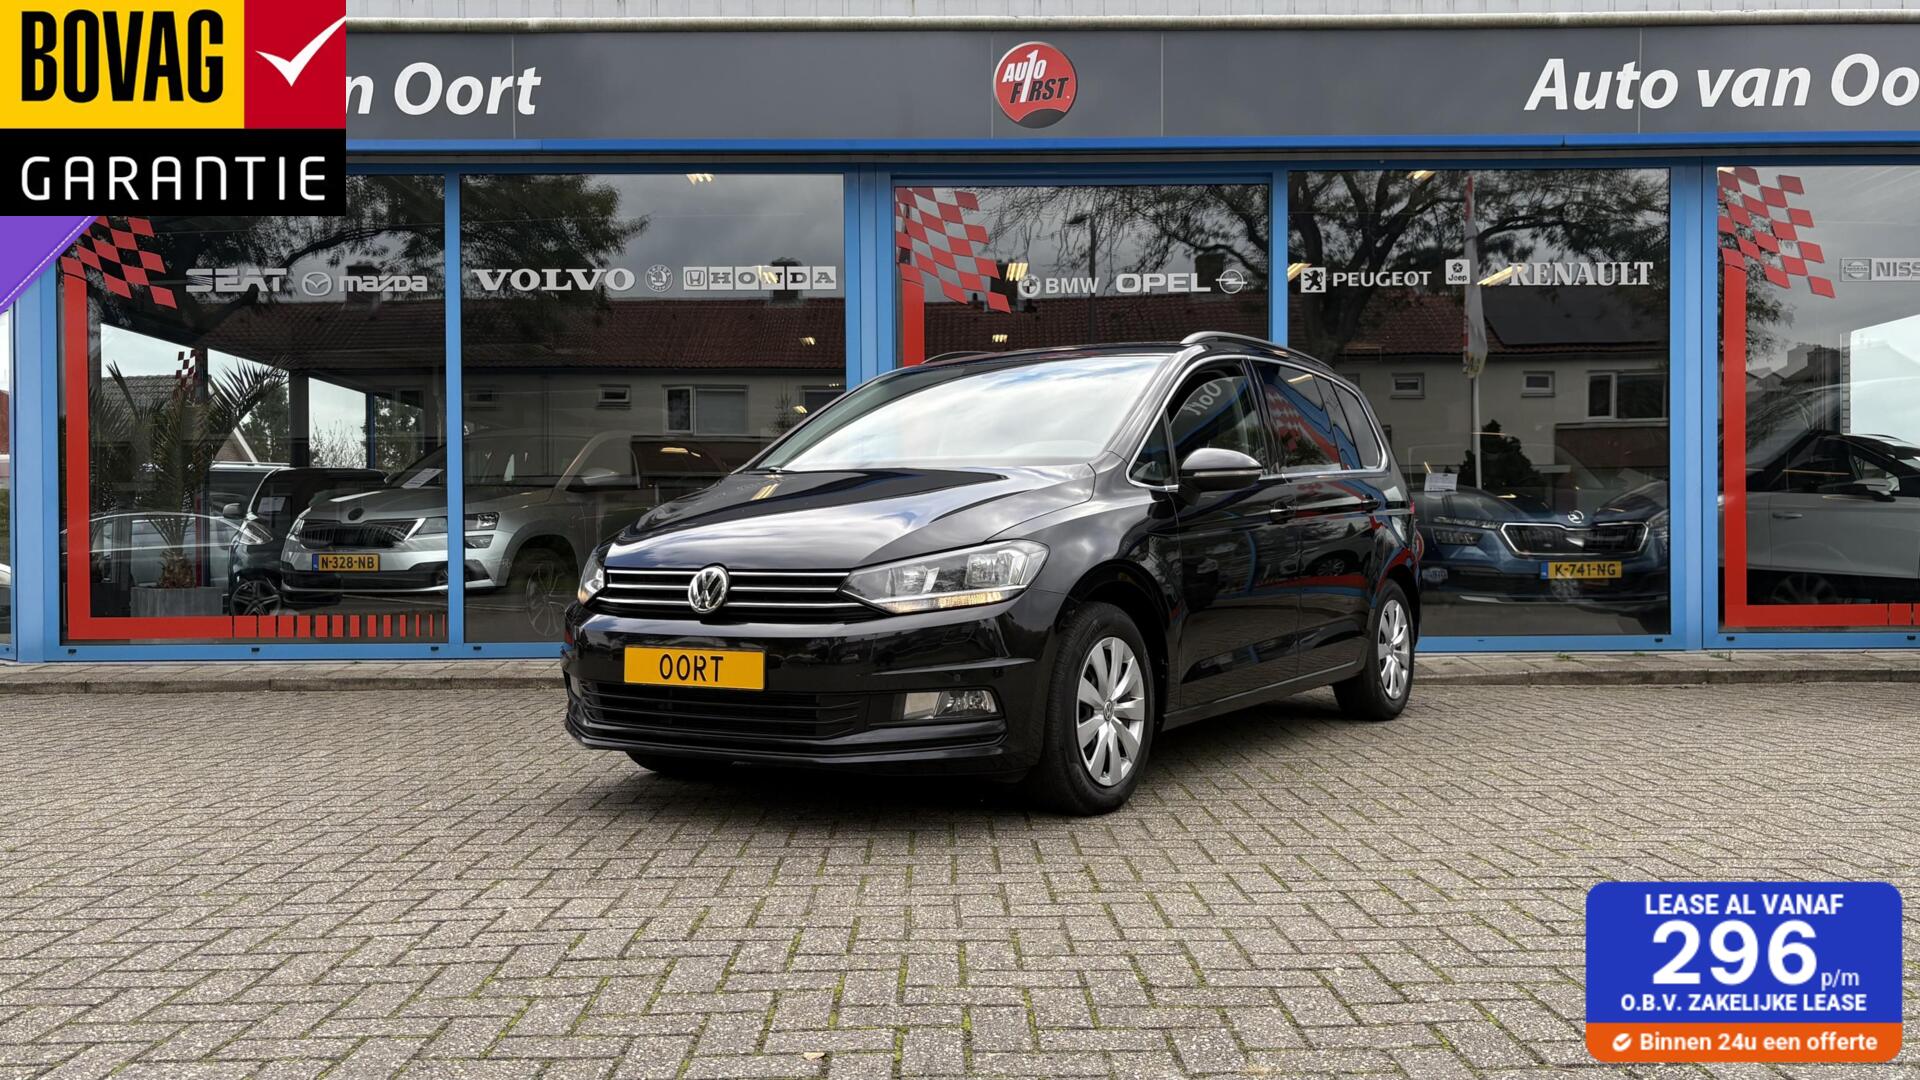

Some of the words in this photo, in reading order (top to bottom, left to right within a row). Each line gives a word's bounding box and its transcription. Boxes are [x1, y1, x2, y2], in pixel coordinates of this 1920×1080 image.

[394, 61, 542, 115] Oort
[1523, 58, 1679, 110] Auto
[1697, 66, 1811, 108] van
[186, 268, 287, 292] SEAT
[471, 268, 635, 291] VOLVO
[709, 271, 836, 285] HONDA
[1045, 277, 1099, 294] BMW
[1116, 272, 1211, 292] OPEL
[1332, 271, 1432, 287] PEUGEOT
[1508, 261, 1654, 286] RENAULT
[321, 556, 375, 569] N-328-NB
[1554, 563, 1616, 576] K-741-NG
[659, 653, 723, 682] OORT
